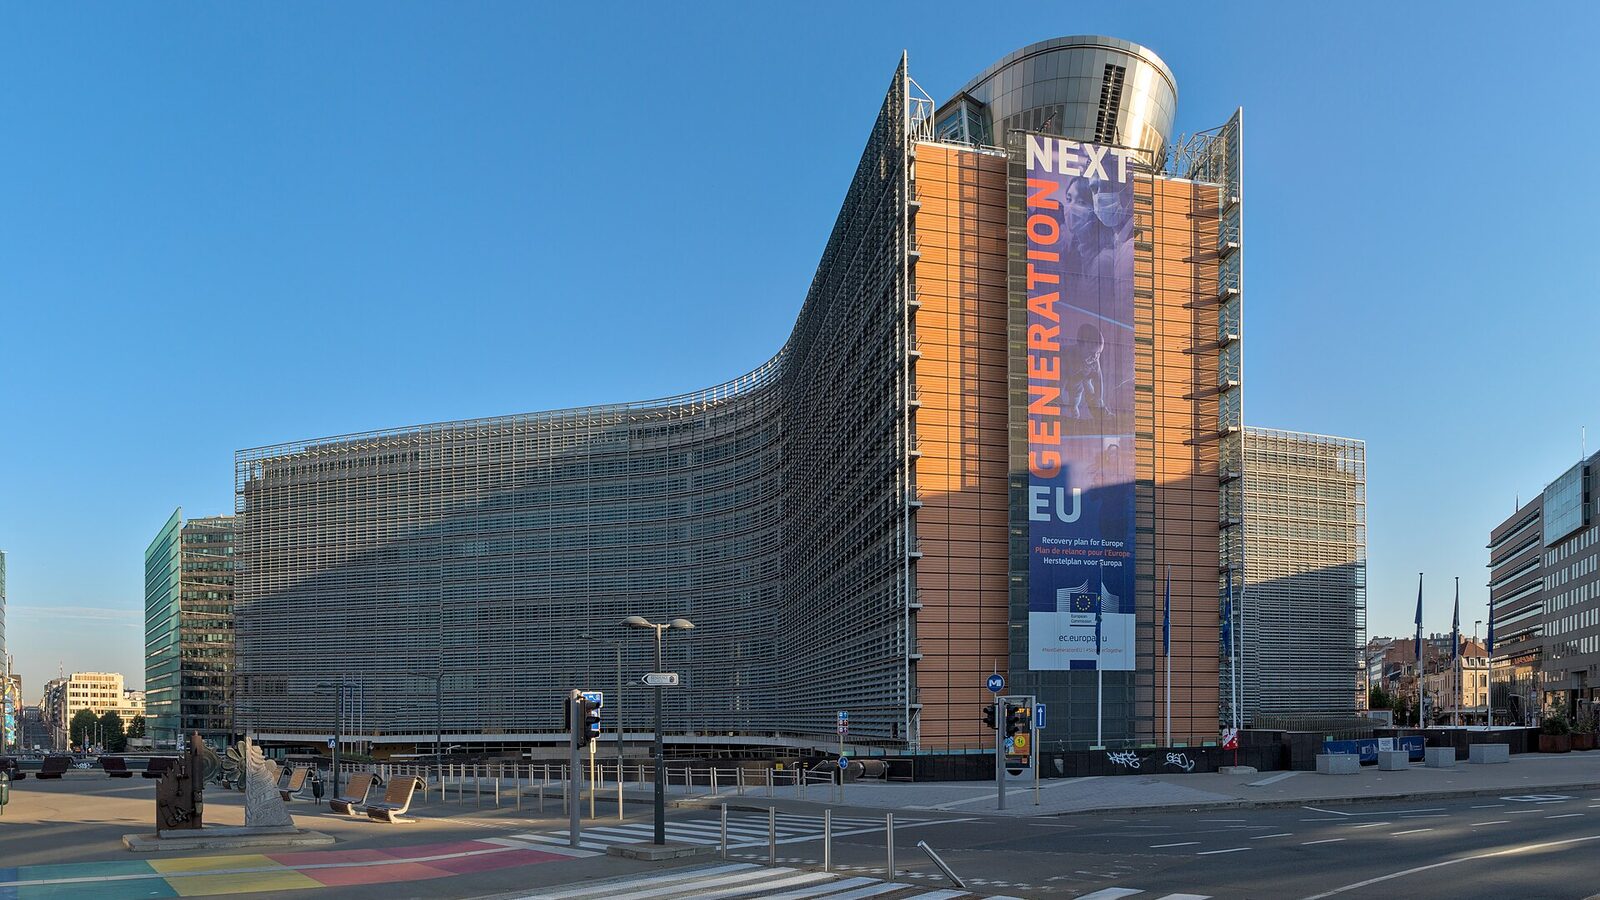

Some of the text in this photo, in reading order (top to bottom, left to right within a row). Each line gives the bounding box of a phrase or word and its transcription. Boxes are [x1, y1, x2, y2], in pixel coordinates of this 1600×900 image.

[1026, 134, 1133, 184] NEXT
[1026, 178, 1061, 479] GENERATION
[1029, 485, 1081, 523] EU
[1042, 536, 1124, 548] Recovery plan for Europe
[1034, 546, 1050, 554] Plan
[1062, 547, 1087, 555] relance
[1043, 556, 1082, 566] Herstelplan
[1058, 634, 1108, 643] ec.europau
